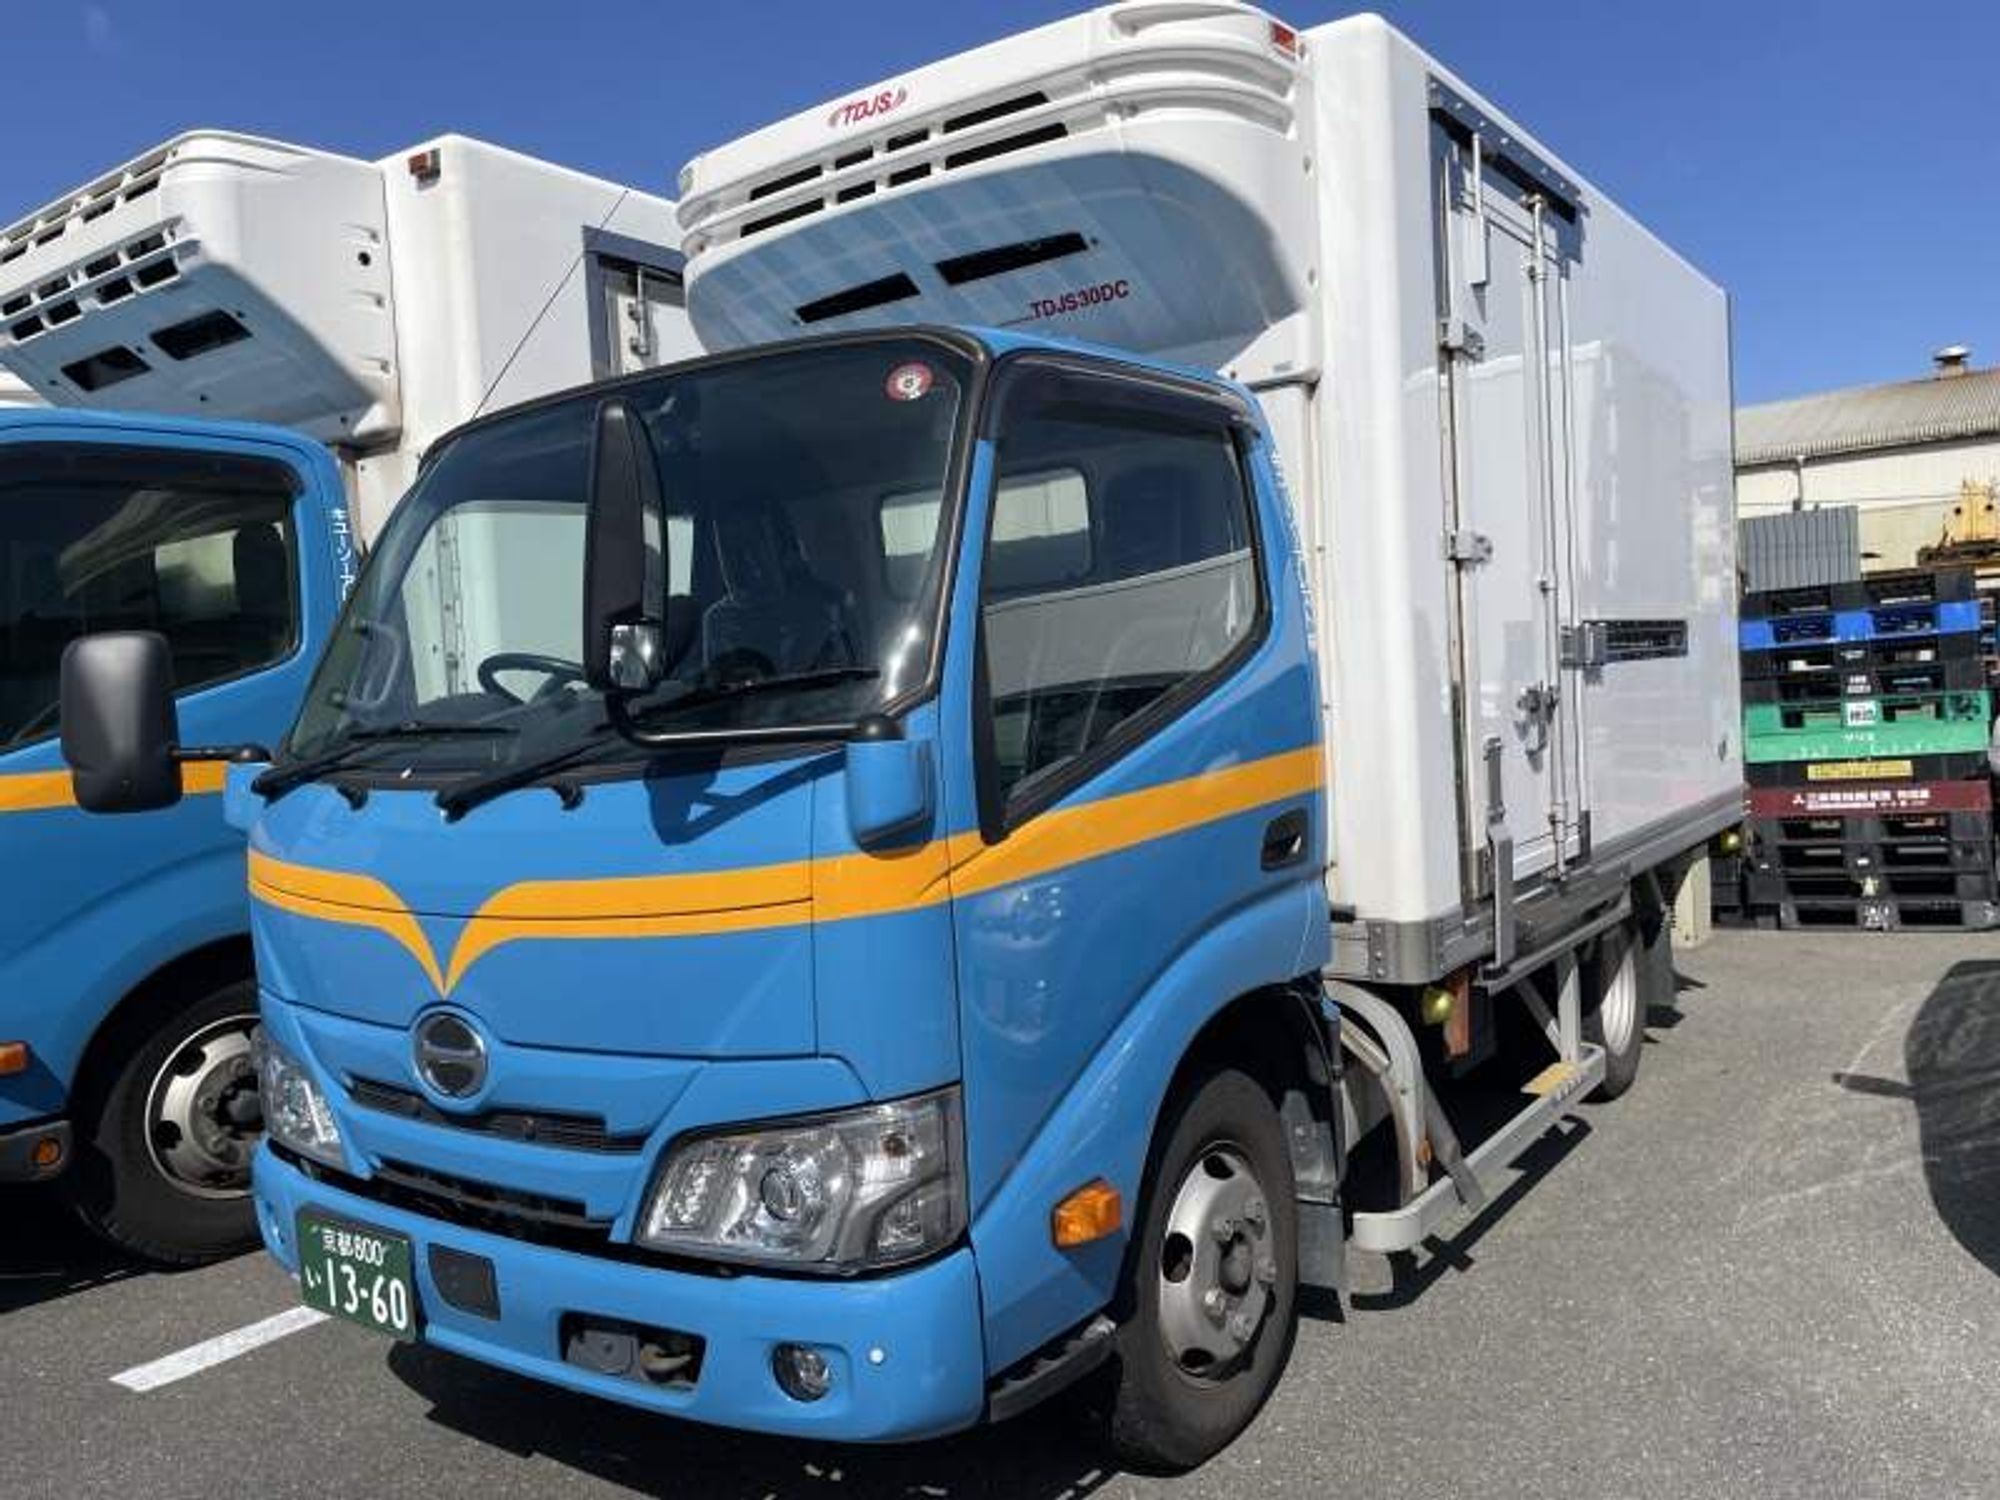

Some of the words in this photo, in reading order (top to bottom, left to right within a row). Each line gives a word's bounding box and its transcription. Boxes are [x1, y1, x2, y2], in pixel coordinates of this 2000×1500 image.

[843, 91, 893, 125] TDJS
[1030, 280, 1129, 318] TDJS30DC
[327, 1257, 409, 1330] 13-60
